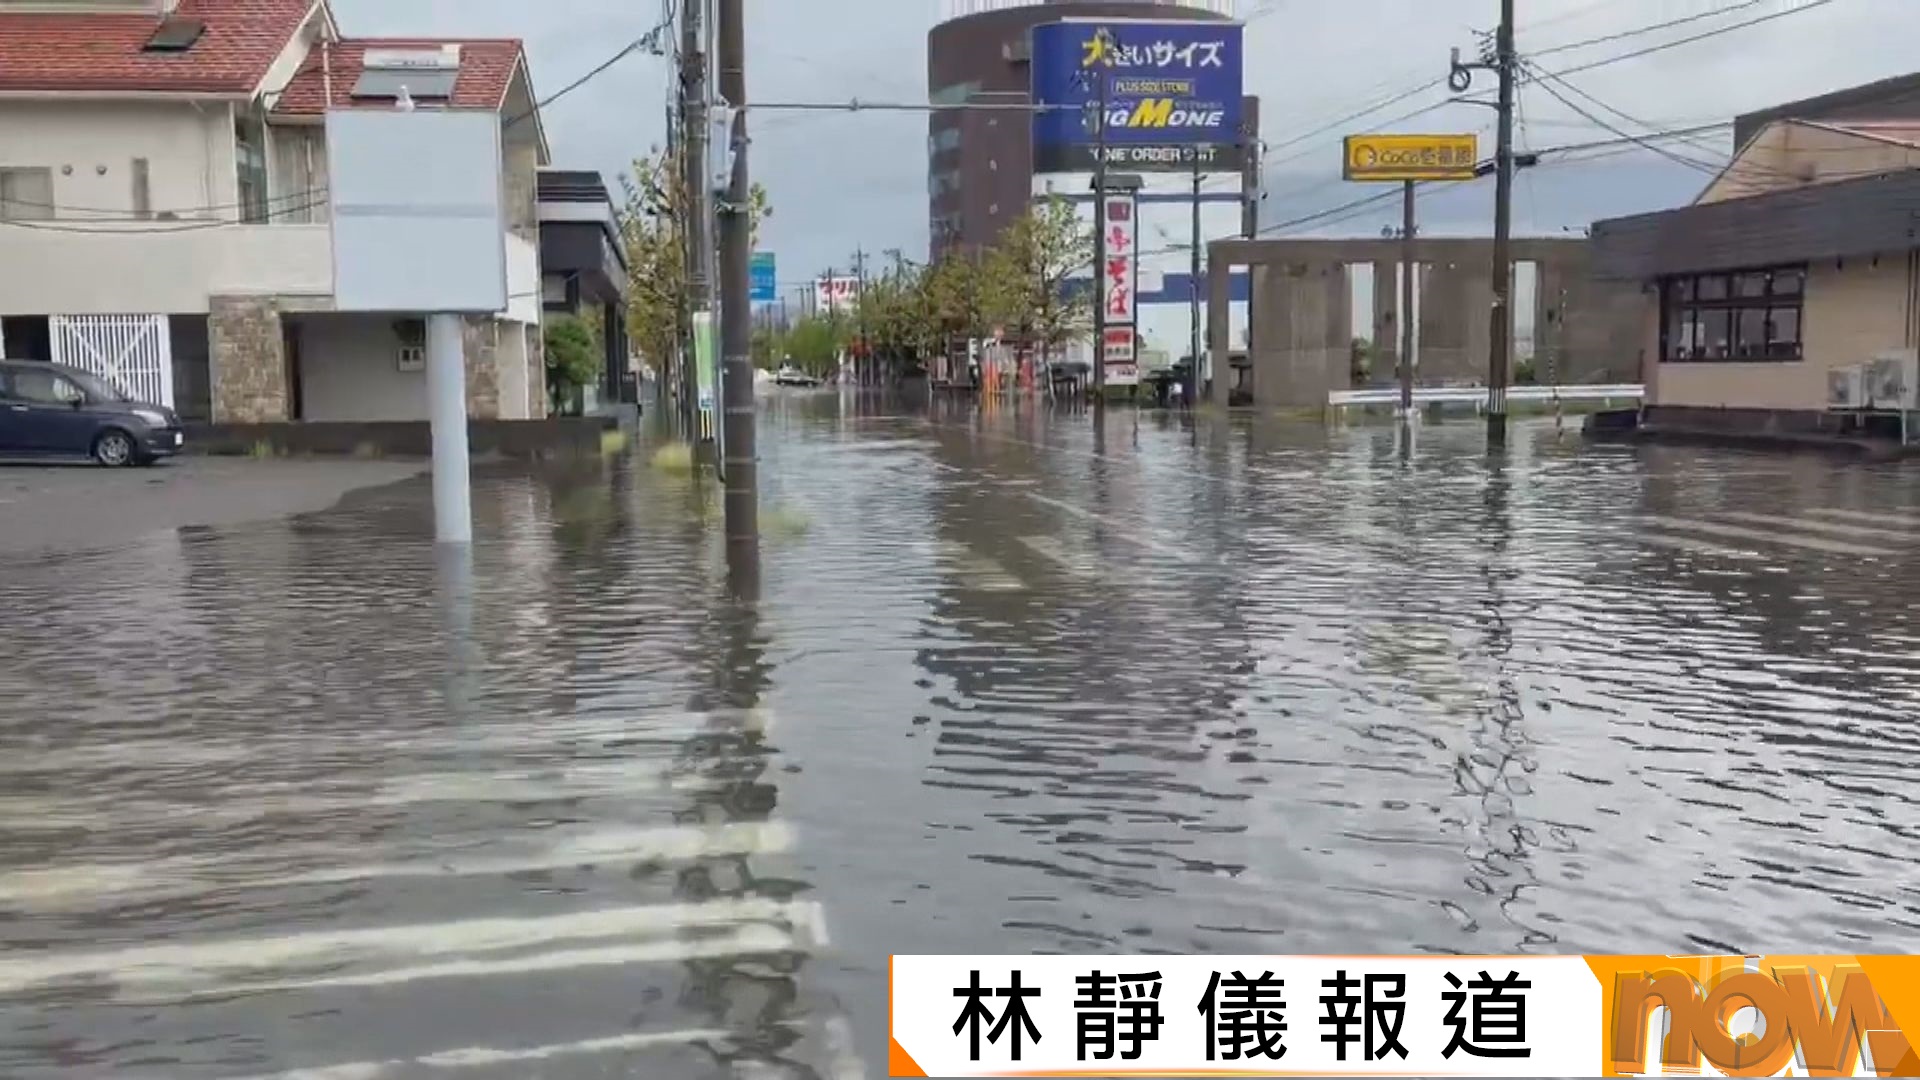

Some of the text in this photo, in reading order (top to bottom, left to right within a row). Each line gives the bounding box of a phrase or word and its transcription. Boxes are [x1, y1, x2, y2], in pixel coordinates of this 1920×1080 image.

[1081, 30, 1225, 68] 大きいサイズ
[1131, 147, 1180, 161] ORDER
